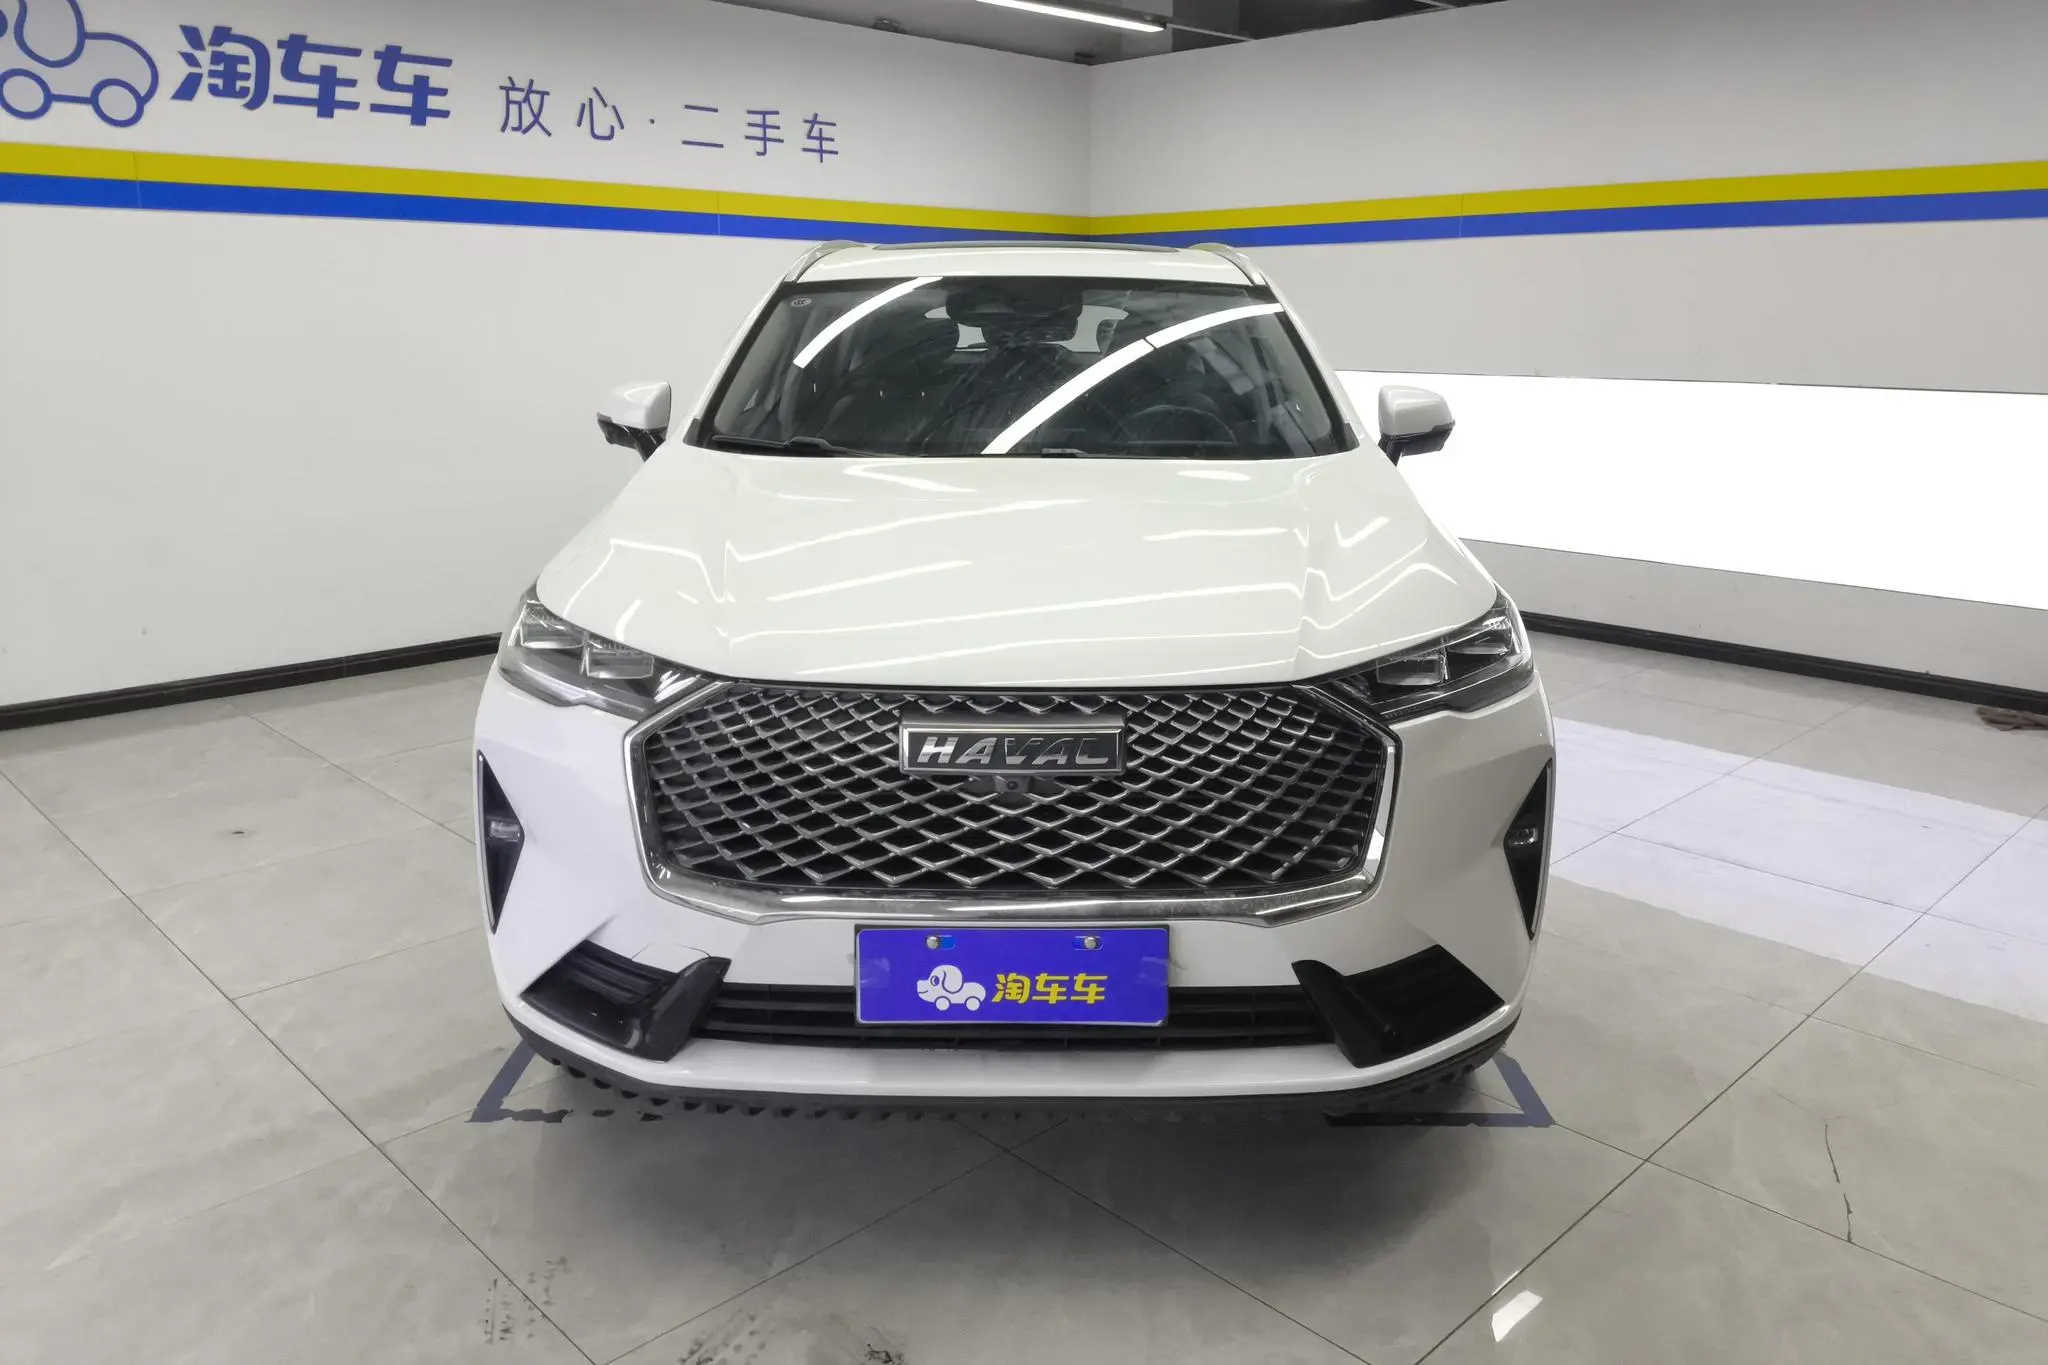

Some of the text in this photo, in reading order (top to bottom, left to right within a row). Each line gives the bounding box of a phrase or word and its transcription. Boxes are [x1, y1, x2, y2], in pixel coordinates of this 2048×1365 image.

[171, 25, 453, 127] 淘车车
[916, 736, 1109, 765] HAVAL
[991, 972, 1109, 1005] 淘车车
